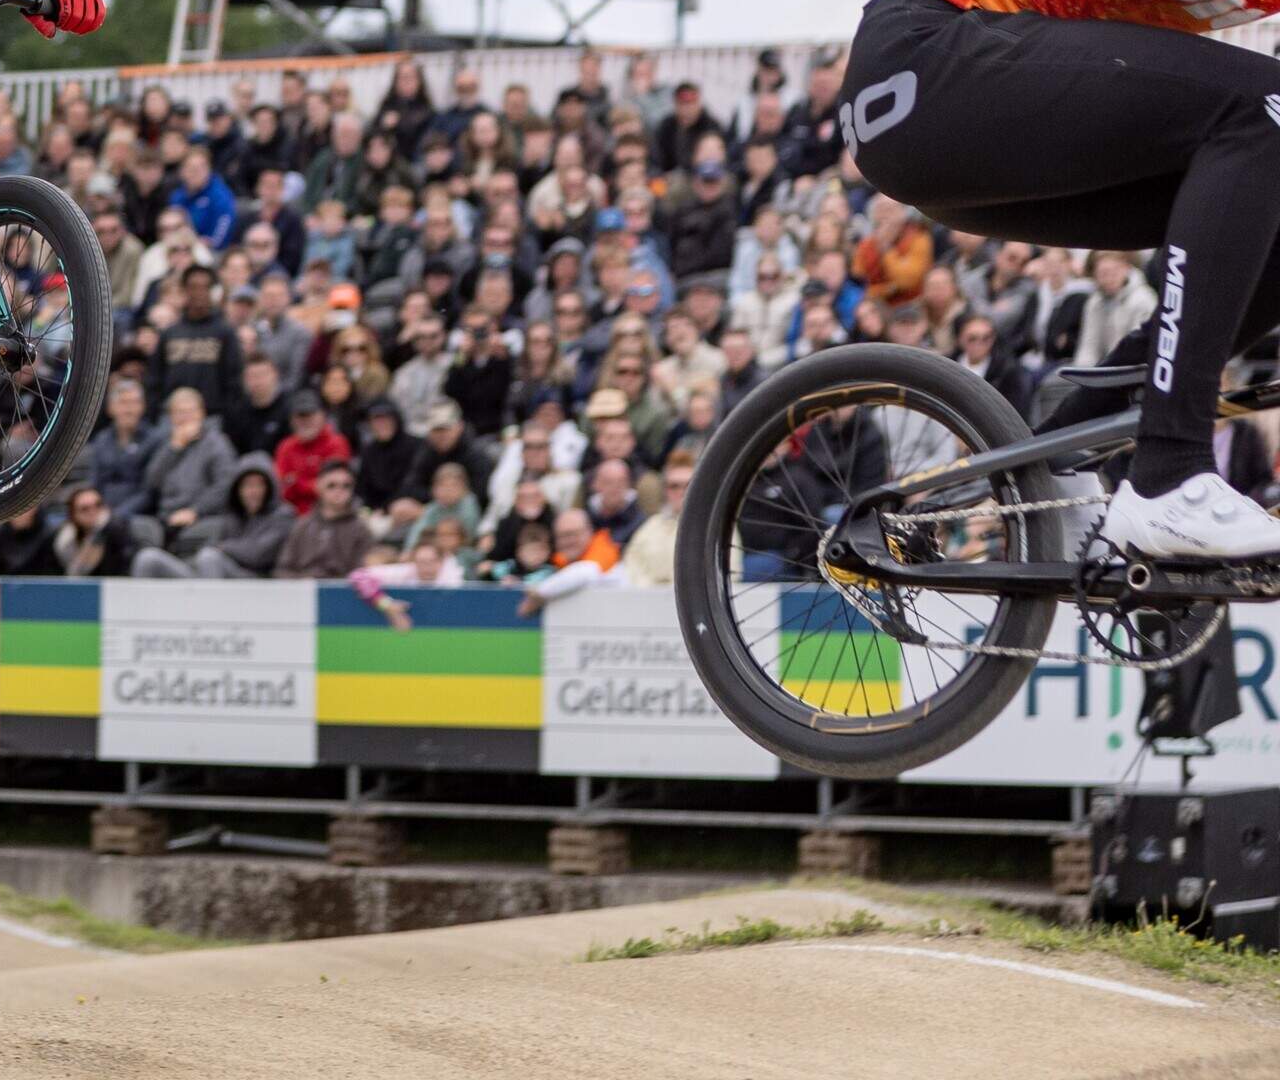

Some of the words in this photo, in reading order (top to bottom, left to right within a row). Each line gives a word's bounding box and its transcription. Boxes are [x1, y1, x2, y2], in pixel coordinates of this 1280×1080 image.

[1152, 243, 1188, 394] MEYBO
[132, 625, 255, 663] provincie
[578, 632, 690, 673] provinc
[113, 669, 297, 709] Gelderland
[556, 677, 718, 717] Gelderla
